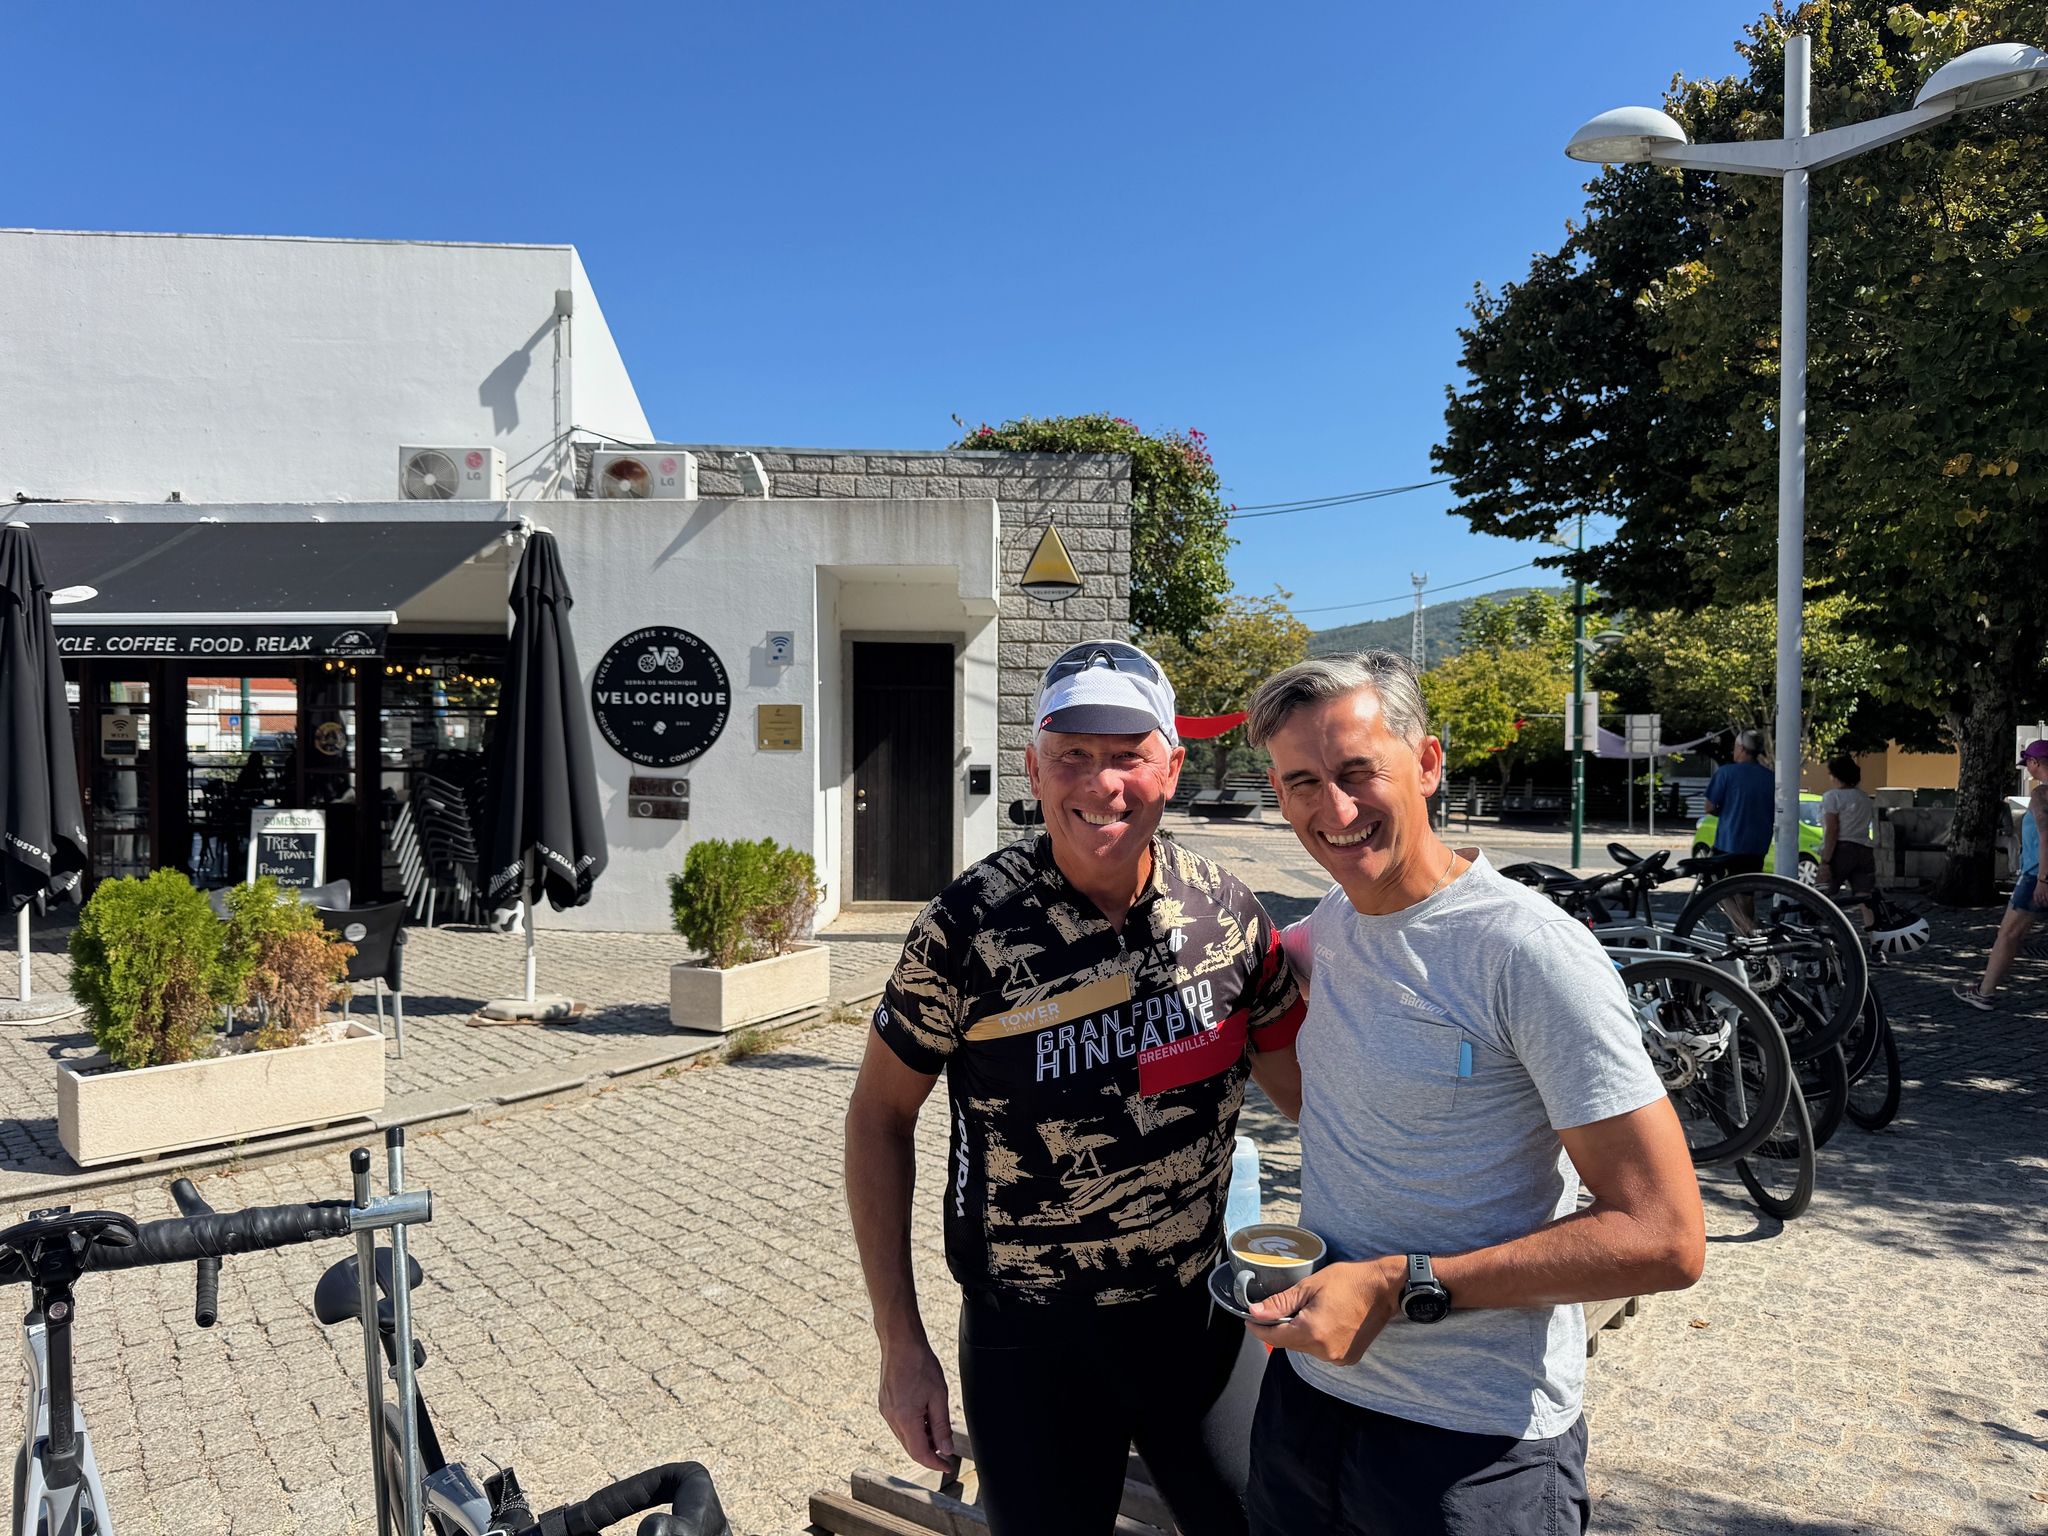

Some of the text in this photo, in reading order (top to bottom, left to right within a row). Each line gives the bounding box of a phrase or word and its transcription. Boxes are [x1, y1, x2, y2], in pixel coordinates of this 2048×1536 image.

[467, 472, 481, 480] LG
[661, 478, 675, 486] LG
[55, 636, 312, 652] YCLE COFFEE FOOD RELAX
[597, 630, 725, 686] CYCLE COFFEE FOOD RELAX
[596, 692, 727, 707] VELOCHIQUE
[598, 710, 621, 746] CICLISMO
[669, 746, 701, 763] COMIDA
[709, 712, 725, 737] RELAX
[264, 816, 312, 826] SOMERSBY
[263, 835, 299, 852] TREK
[275, 850, 316, 861] TRAVEL
[259, 862, 295, 875] Private
[998, 1002, 1060, 1028] TOWER
[1037, 979, 1213, 1055] GRAN FONDO
[1036, 1000, 1218, 1082] HINCAPIE
[1139, 1035, 1209, 1065] GREENVILLE,
